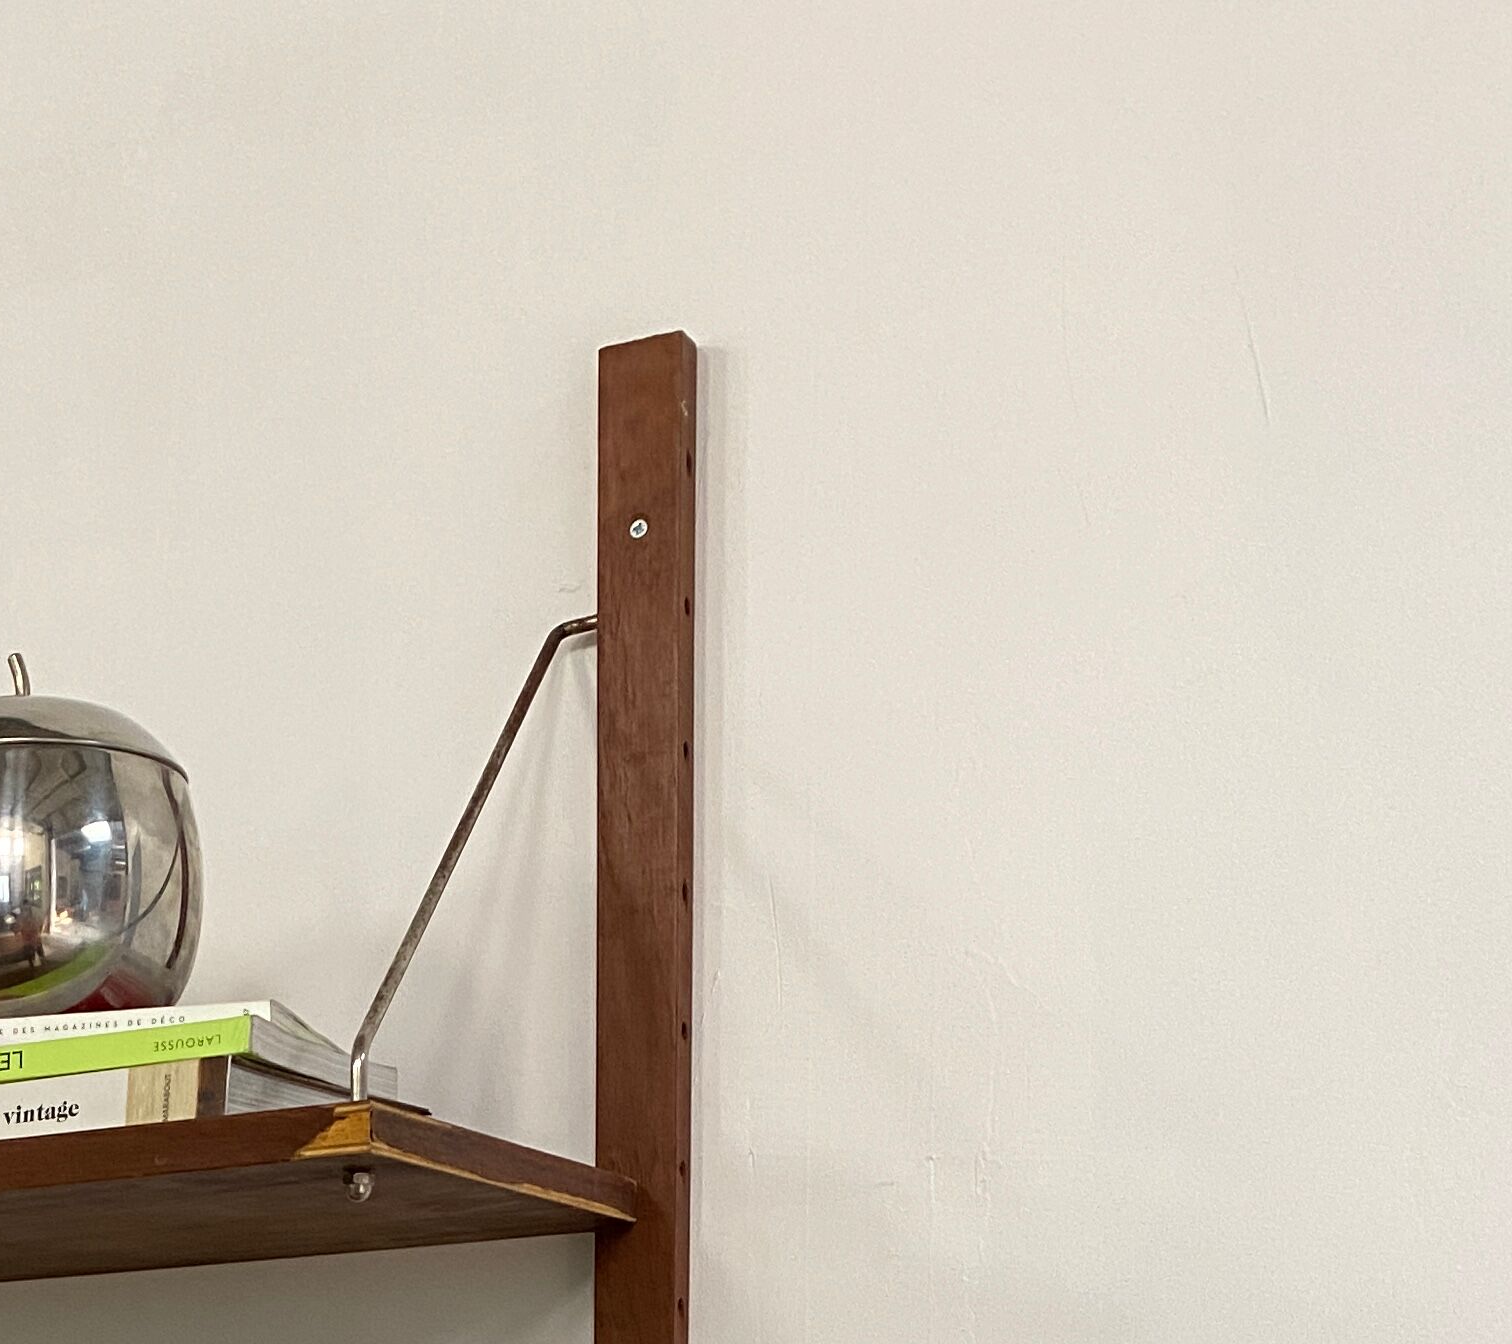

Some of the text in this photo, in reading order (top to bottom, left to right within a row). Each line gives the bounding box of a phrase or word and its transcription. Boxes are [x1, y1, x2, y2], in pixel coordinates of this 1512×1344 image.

[12, 1026, 36, 1035] DES
[44, 1021, 119, 1032] MAGAZINES
[127, 1018, 142, 1027] DE
[151, 1015, 186, 1025] DÉCO
[153, 1033, 221, 1053] LAROUSSE
[0, 1050, 23, 1071] LE
[3, 1100, 80, 1125] vintage
